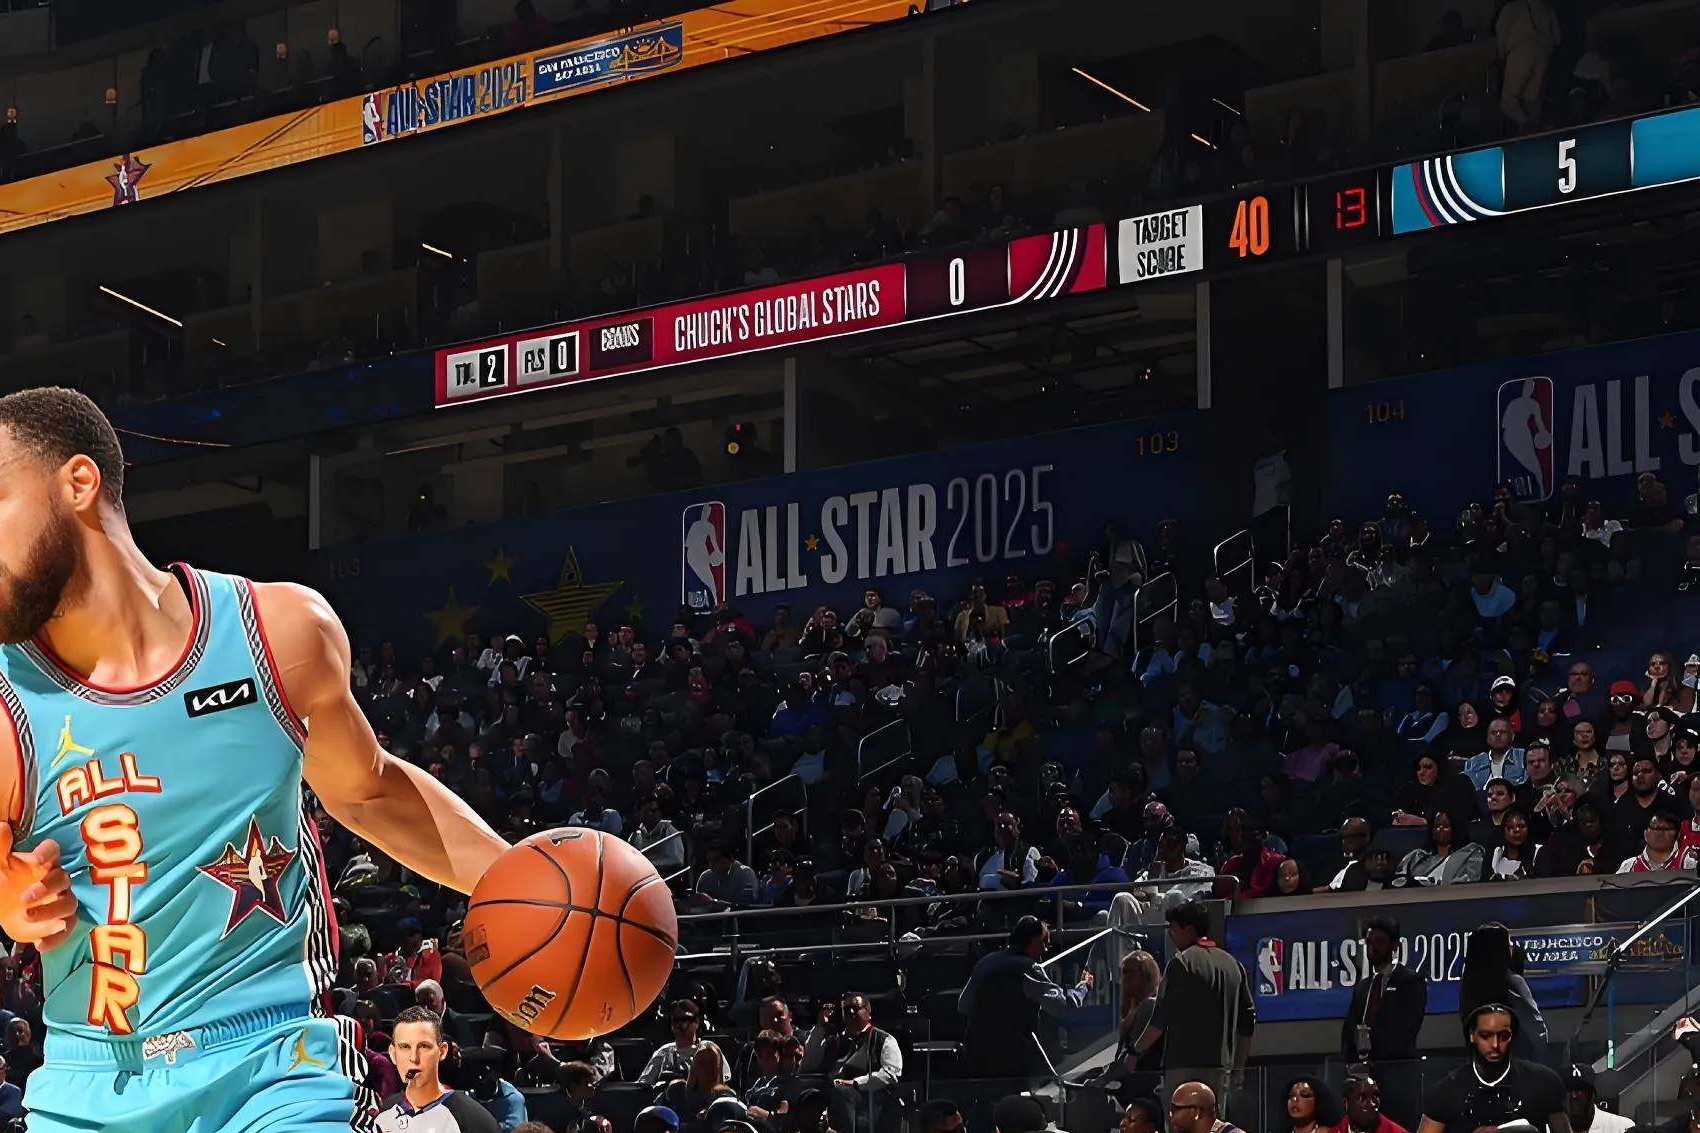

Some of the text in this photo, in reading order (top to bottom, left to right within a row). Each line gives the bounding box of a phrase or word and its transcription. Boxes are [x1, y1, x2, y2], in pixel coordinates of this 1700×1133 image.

[479, 60, 527, 112] 2025
[1557, 138, 1577, 193] 5
[1133, 209, 1189, 246] TARGET
[1229, 195, 1269, 257] 40
[1335, 188, 1366, 230] 13
[949, 257, 965, 306] 0
[674, 279, 880, 351] CHUCK'S GLOBAL STARS
[487, 354, 496, 383] 2
[558, 340, 567, 370] 0
[1134, 431, 1180, 457] 103
[946, 464, 1054, 567] 2025
[192, 684, 249, 712] KIA
[57, 752, 162, 817] ALL
[80, 803, 148, 1035] STAR
